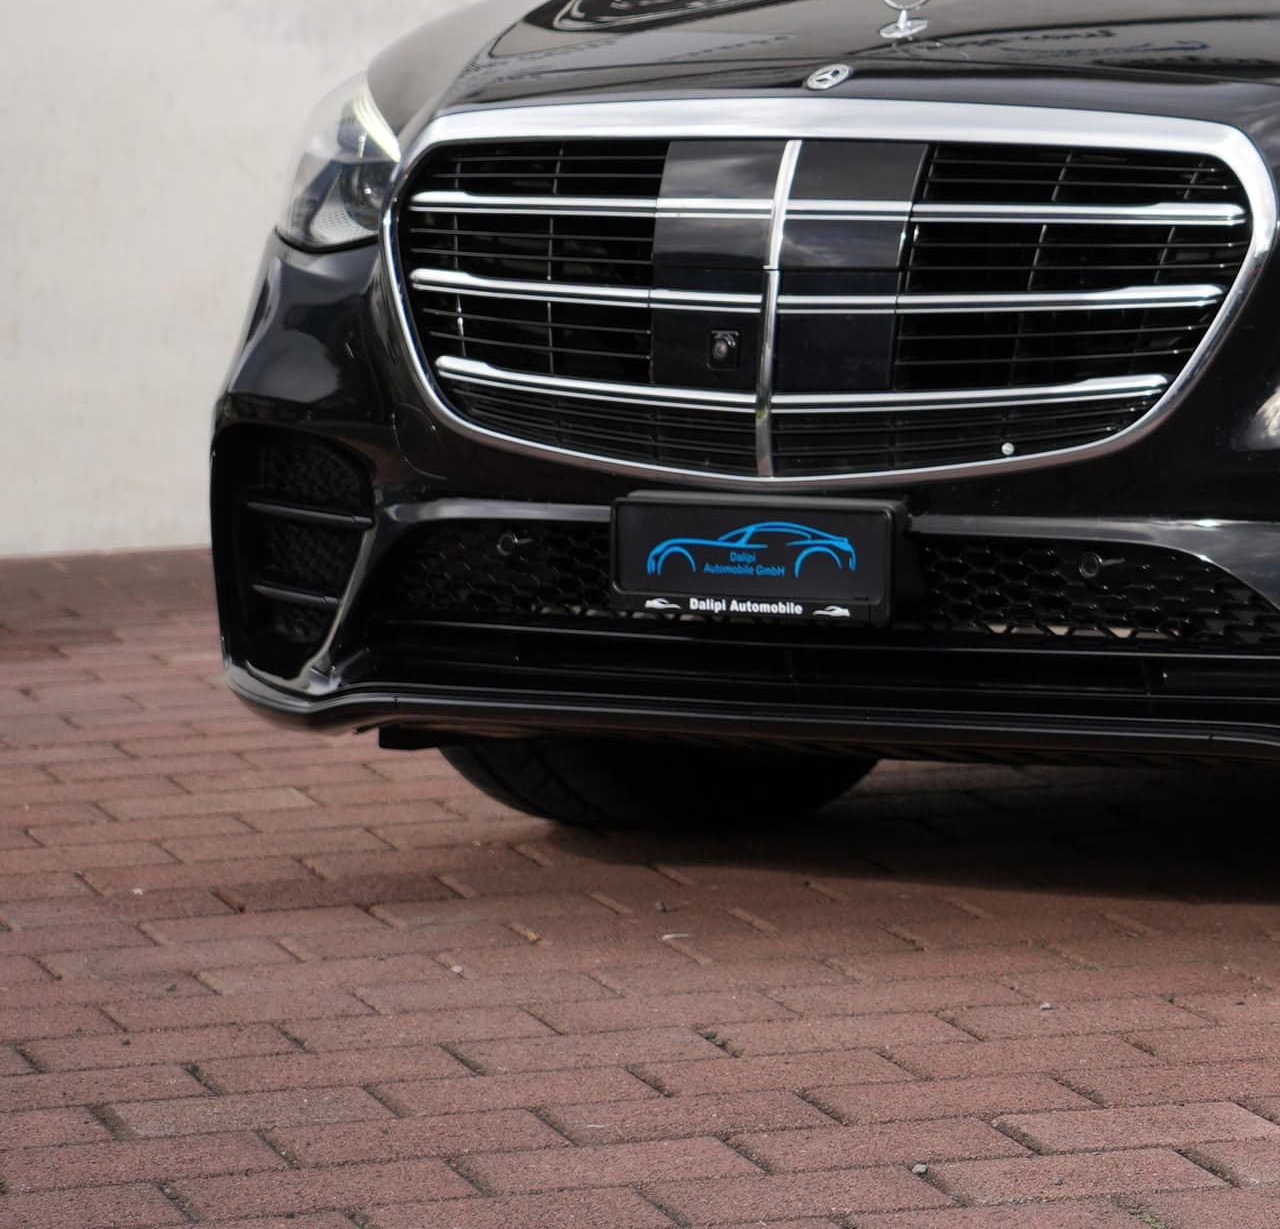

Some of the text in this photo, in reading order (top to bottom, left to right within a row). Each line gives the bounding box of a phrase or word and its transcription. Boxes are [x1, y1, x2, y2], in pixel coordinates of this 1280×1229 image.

[729, 550, 757, 563] Dalipi
[703, 562, 785, 577] Automobile GmbH
[689, 597, 803, 615] Dalipi Automobile
